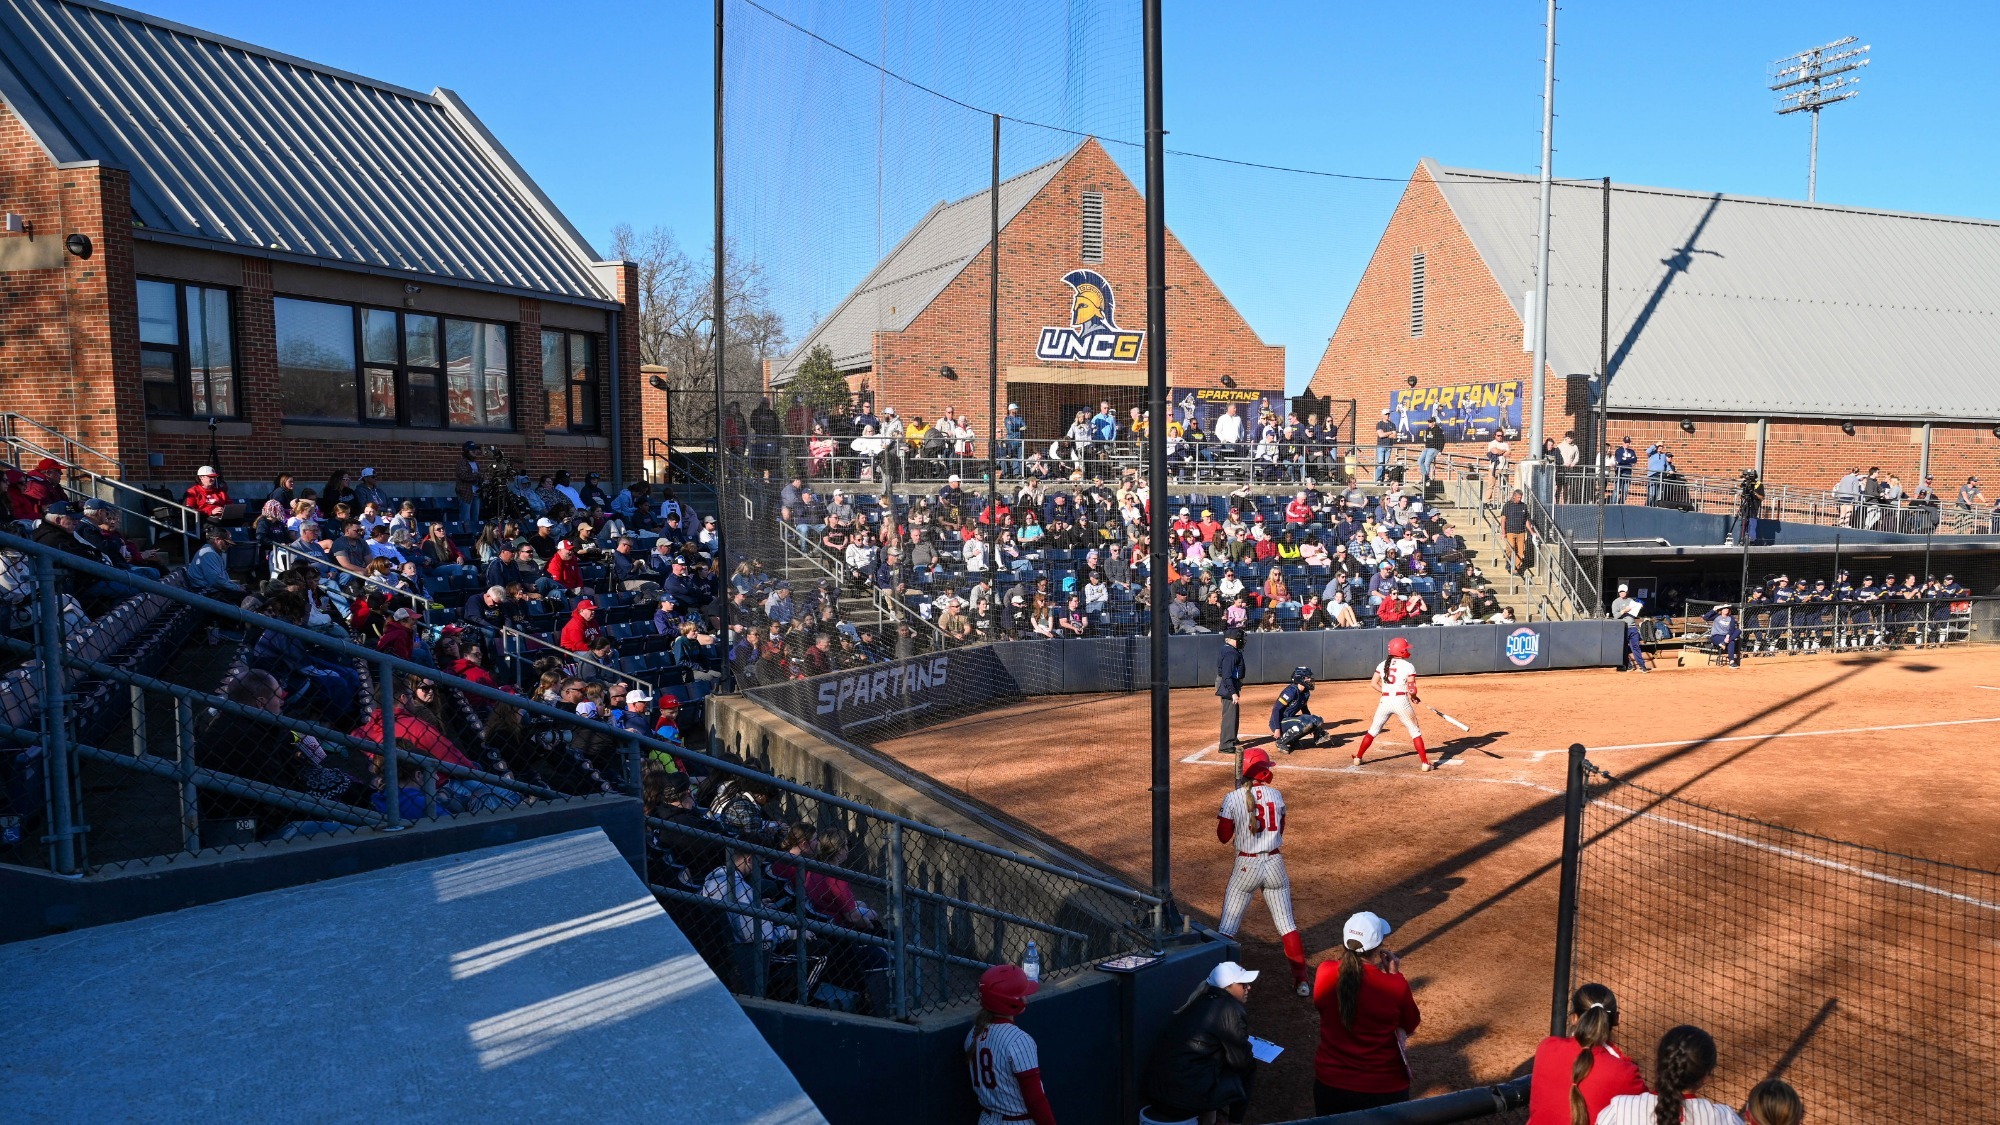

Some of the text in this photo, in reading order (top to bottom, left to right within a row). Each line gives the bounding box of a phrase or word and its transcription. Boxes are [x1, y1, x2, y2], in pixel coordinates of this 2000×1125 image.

[1039, 330, 1141, 359] UNCG
[1197, 390, 1260, 400] SPARTANS
[1397, 381, 1517, 412] SPARTANS
[816, 656, 949, 715] SPARTANS
[1387, 667, 1397, 685] 5
[973, 1035, 998, 1090] 18
